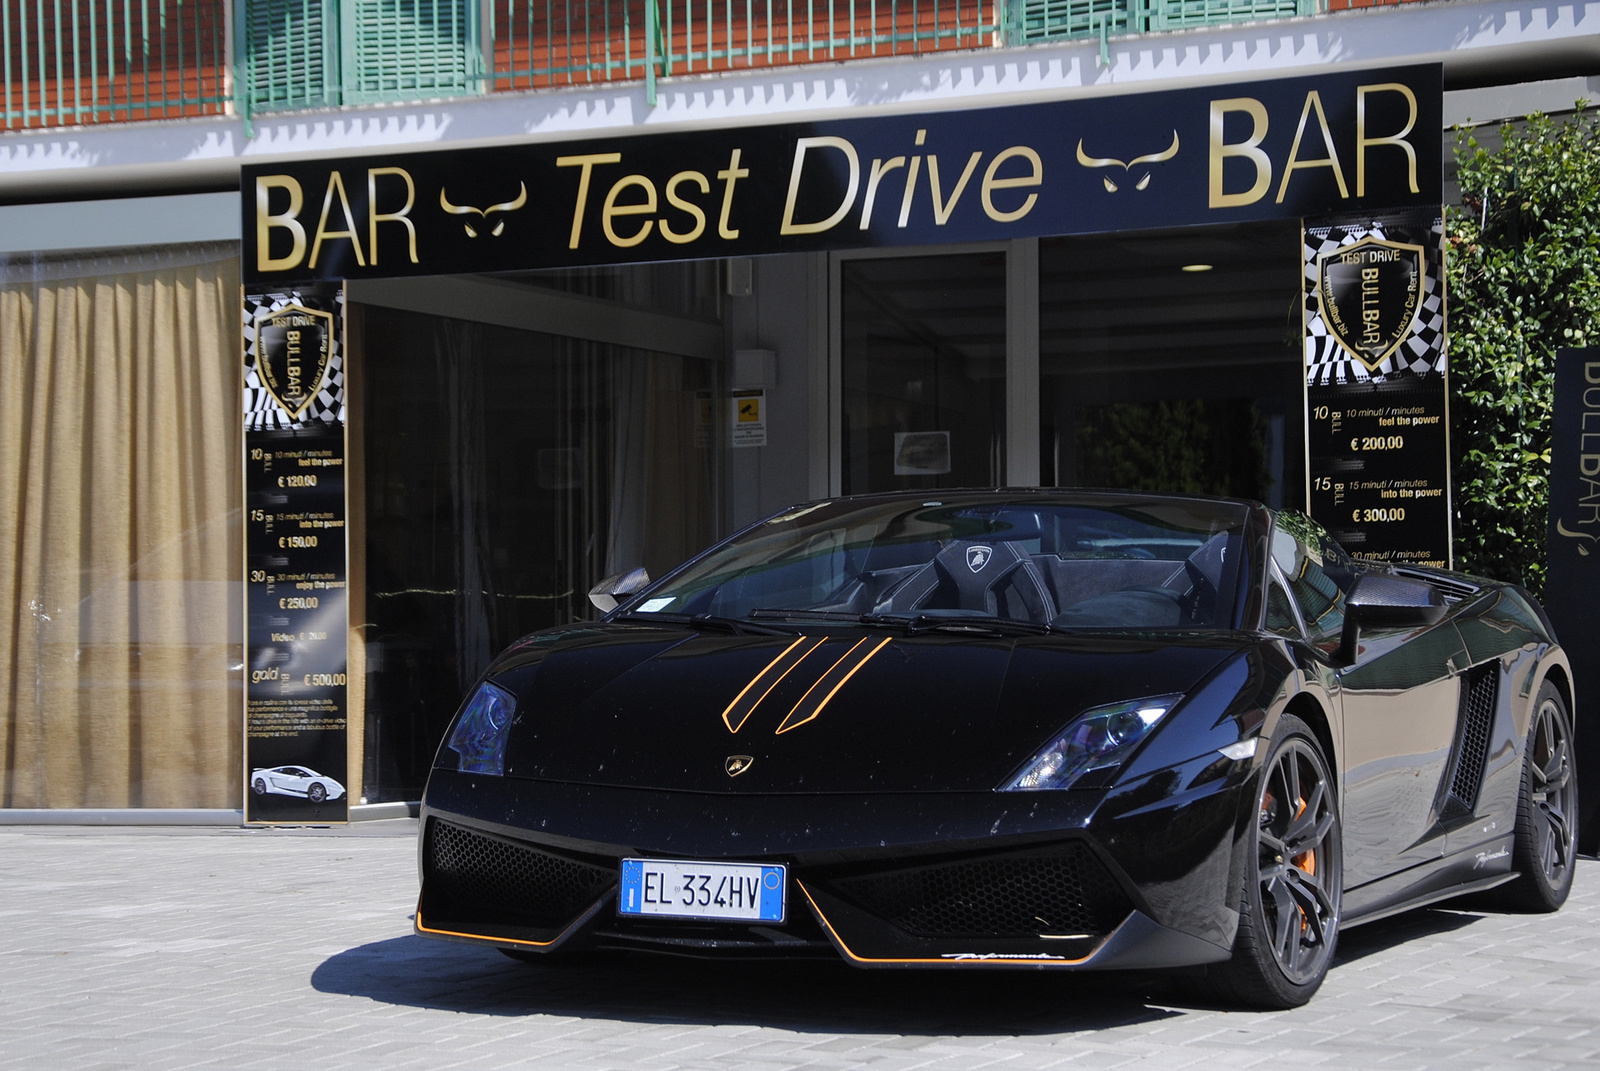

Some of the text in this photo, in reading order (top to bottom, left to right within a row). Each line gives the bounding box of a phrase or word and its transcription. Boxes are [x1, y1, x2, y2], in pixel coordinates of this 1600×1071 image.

[256, 82, 1420, 272] BAR Test Drive BAR
[1340, 249, 1400, 264] TEST DRIVE
[1324, 274, 1349, 337] www.bullbar.biz
[1361, 267, 1380, 344] BULLBAR
[1392, 270, 1417, 338] Luxury Car Rent
[272, 315, 316, 328] TEST DRIVE
[287, 330, 301, 395] BULLBAR
[1313, 405, 1329, 420] 10
[1346, 409, 1357, 418] 10
[1358, 407, 1384, 417] minuti
[1391, 406, 1425, 415] minutes
[1331, 411, 1341, 435] BULL
[1379, 415, 1439, 426] feel the power
[1351, 435, 1404, 451] € 200,00
[251, 448, 263, 460] 10
[1314, 477, 1331, 491] 15
[1349, 481, 1359, 490] 15
[1361, 480, 1387, 489] minuti
[1394, 479, 1428, 488] minutes
[1334, 483, 1344, 506] BULL
[1381, 488, 1443, 499] into the power
[251, 509, 264, 521] 15
[1352, 507, 1405, 522] € 300,00
[287, 535, 318, 548] 150,00
[1397, 549, 1431, 558] minutes
[250, 570, 266, 582] 30
[287, 597, 318, 609] 250,00
[252, 667, 279, 684] gold
[312, 673, 346, 687] 500,00
[644, 872, 760, 909] EL 334HV
